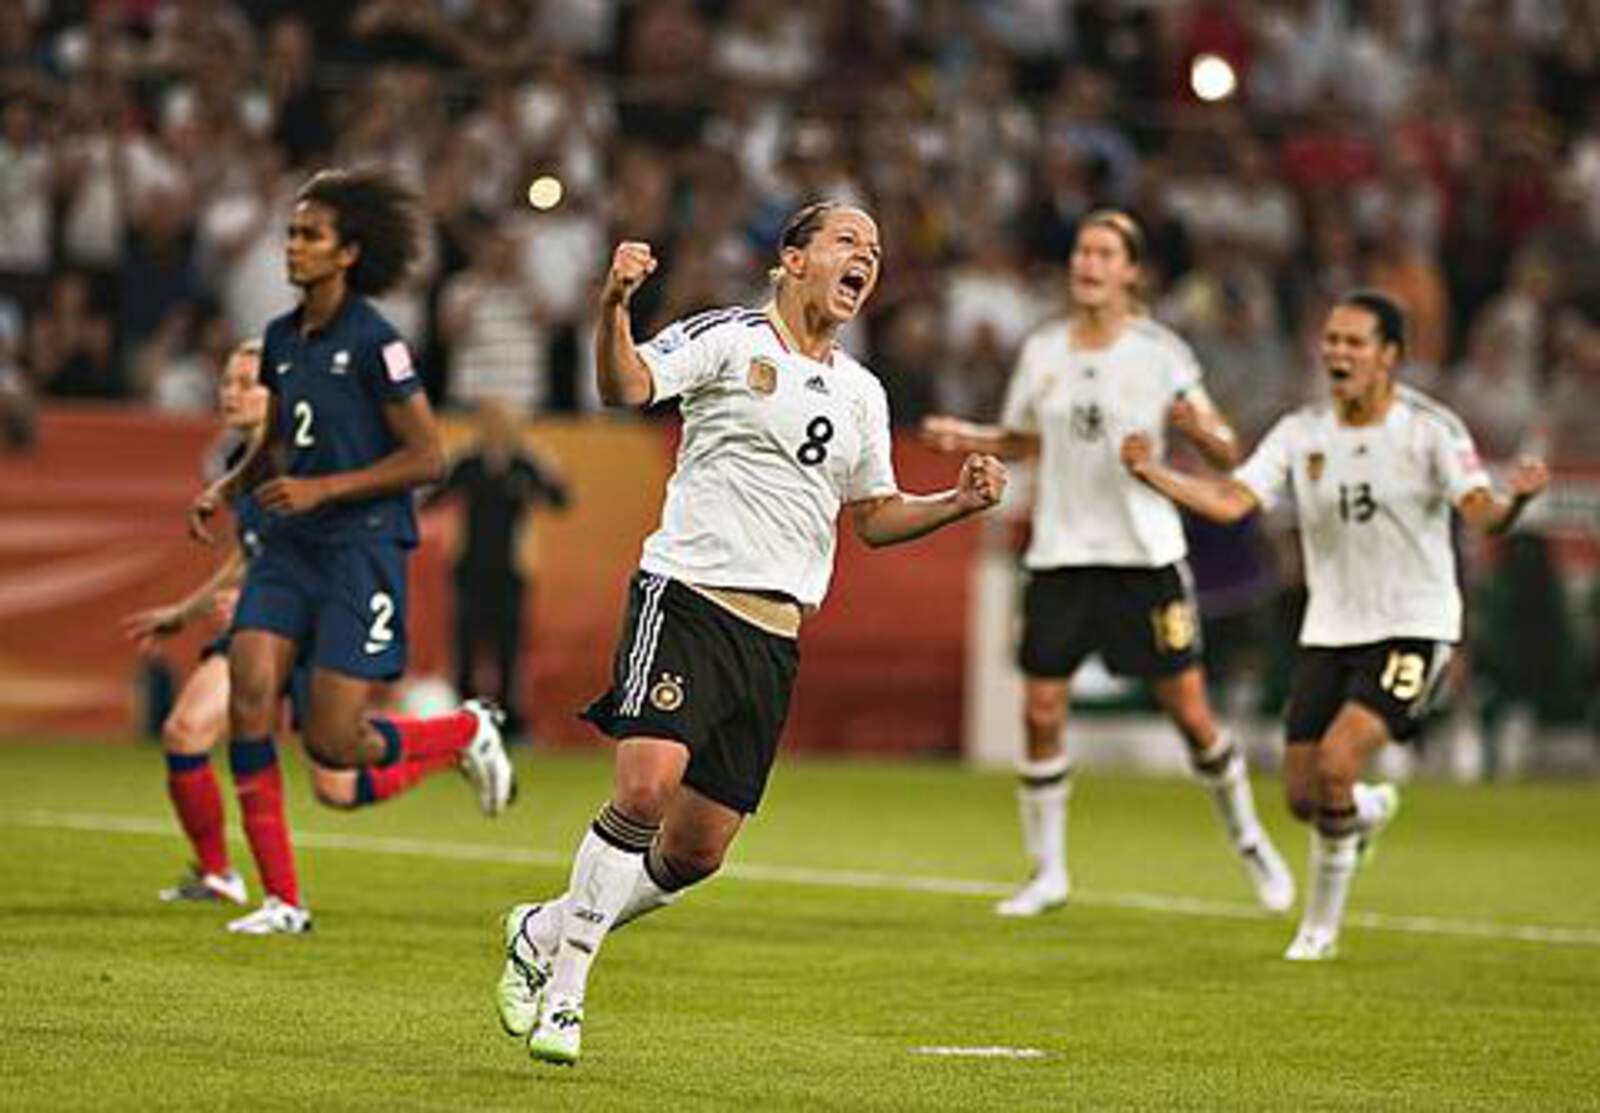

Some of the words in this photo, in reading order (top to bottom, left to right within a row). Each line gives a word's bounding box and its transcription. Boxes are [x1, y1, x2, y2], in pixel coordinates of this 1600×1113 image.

[294, 401, 315, 448] 2
[797, 416, 834, 466] 8
[1339, 483, 1377, 522] 13
[369, 591, 394, 641] 2
[1380, 649, 1425, 701] 13
